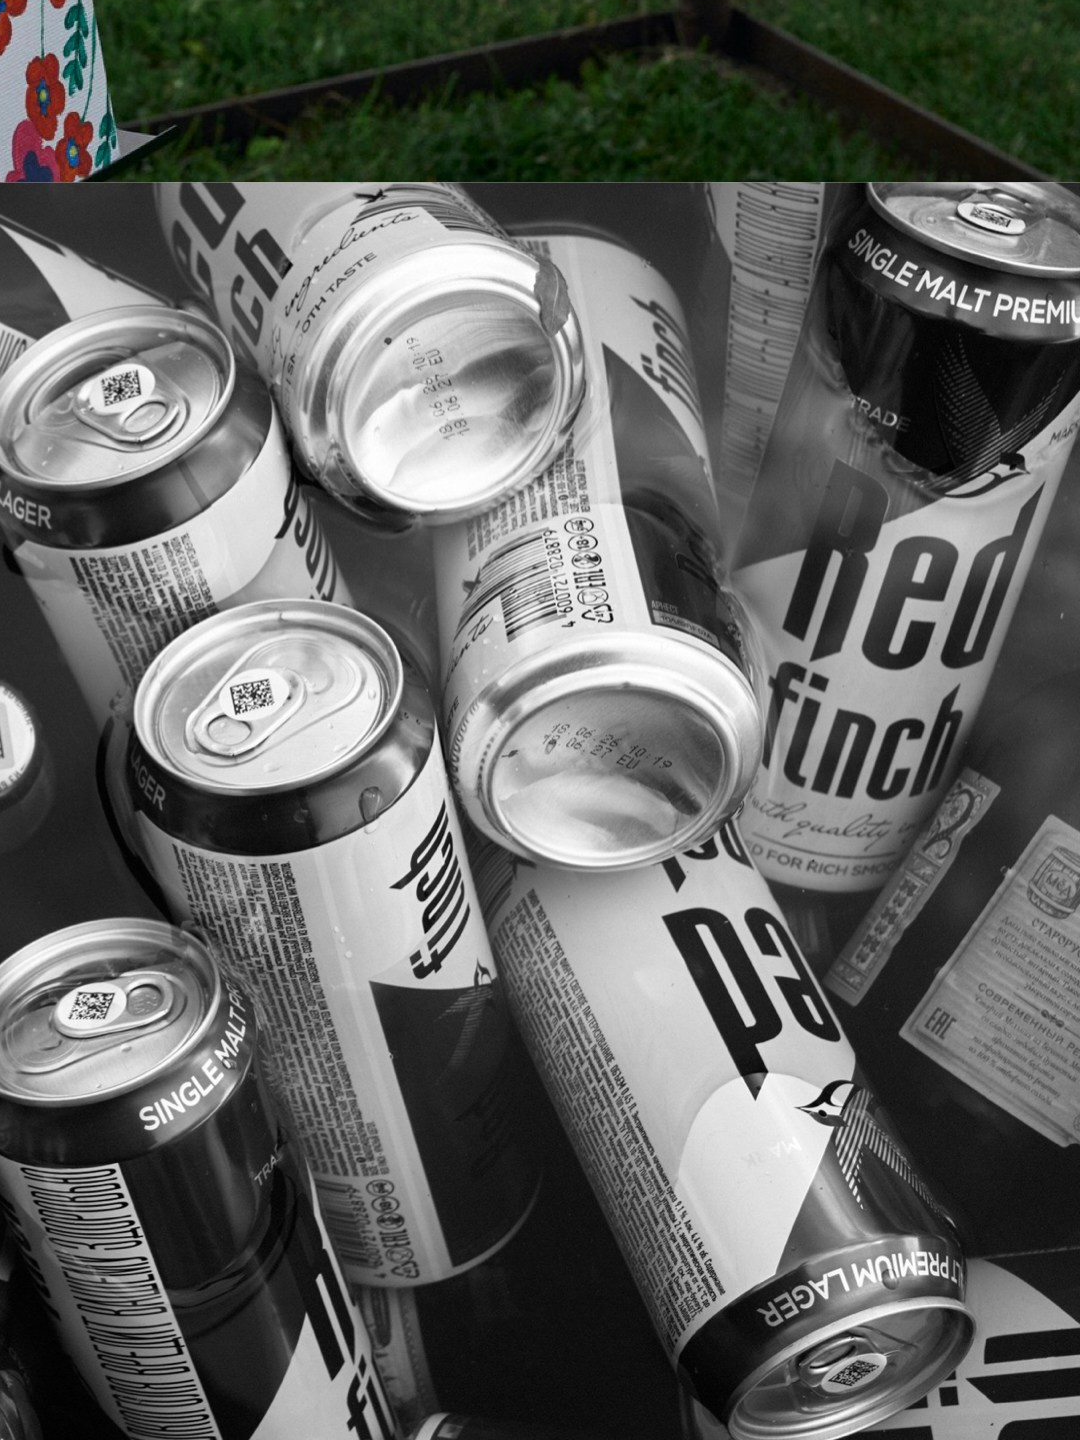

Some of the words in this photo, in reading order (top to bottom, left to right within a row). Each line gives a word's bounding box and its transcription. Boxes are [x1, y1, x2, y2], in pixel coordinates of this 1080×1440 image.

[328, 251, 378, 294] TASTE
[847, 227, 919, 288] SINGLE
[915, 275, 993, 316] MALT
[993, 292, 1080, 325] PREMIU
[542, 527, 564, 569] 028879
[781, 458, 1046, 672] Red
[551, 571, 573, 614] 600721
[560, 619, 576, 628] 4
[761, 661, 965, 801] finch
[782, 813, 892, 852] quality
[764, 847, 805, 873] FOR
[806, 858, 850, 878] RICH
[389, 798, 473, 981] finch
[1029, 916, 1080, 955] СТАРОРУ
[923, 1005, 957, 1040] EAC
[975, 981, 1066, 1046] СОВРЕМЕННЫЙ
[138, 1059, 225, 1132] SINGLE
[214, 1011, 248, 1068] MALT
[19, 1164, 144, 1256] ЗДОРОВЬЮ
[850, 1250, 950, 1288] PREMIUM
[756, 1267, 851, 1329] LAGER
